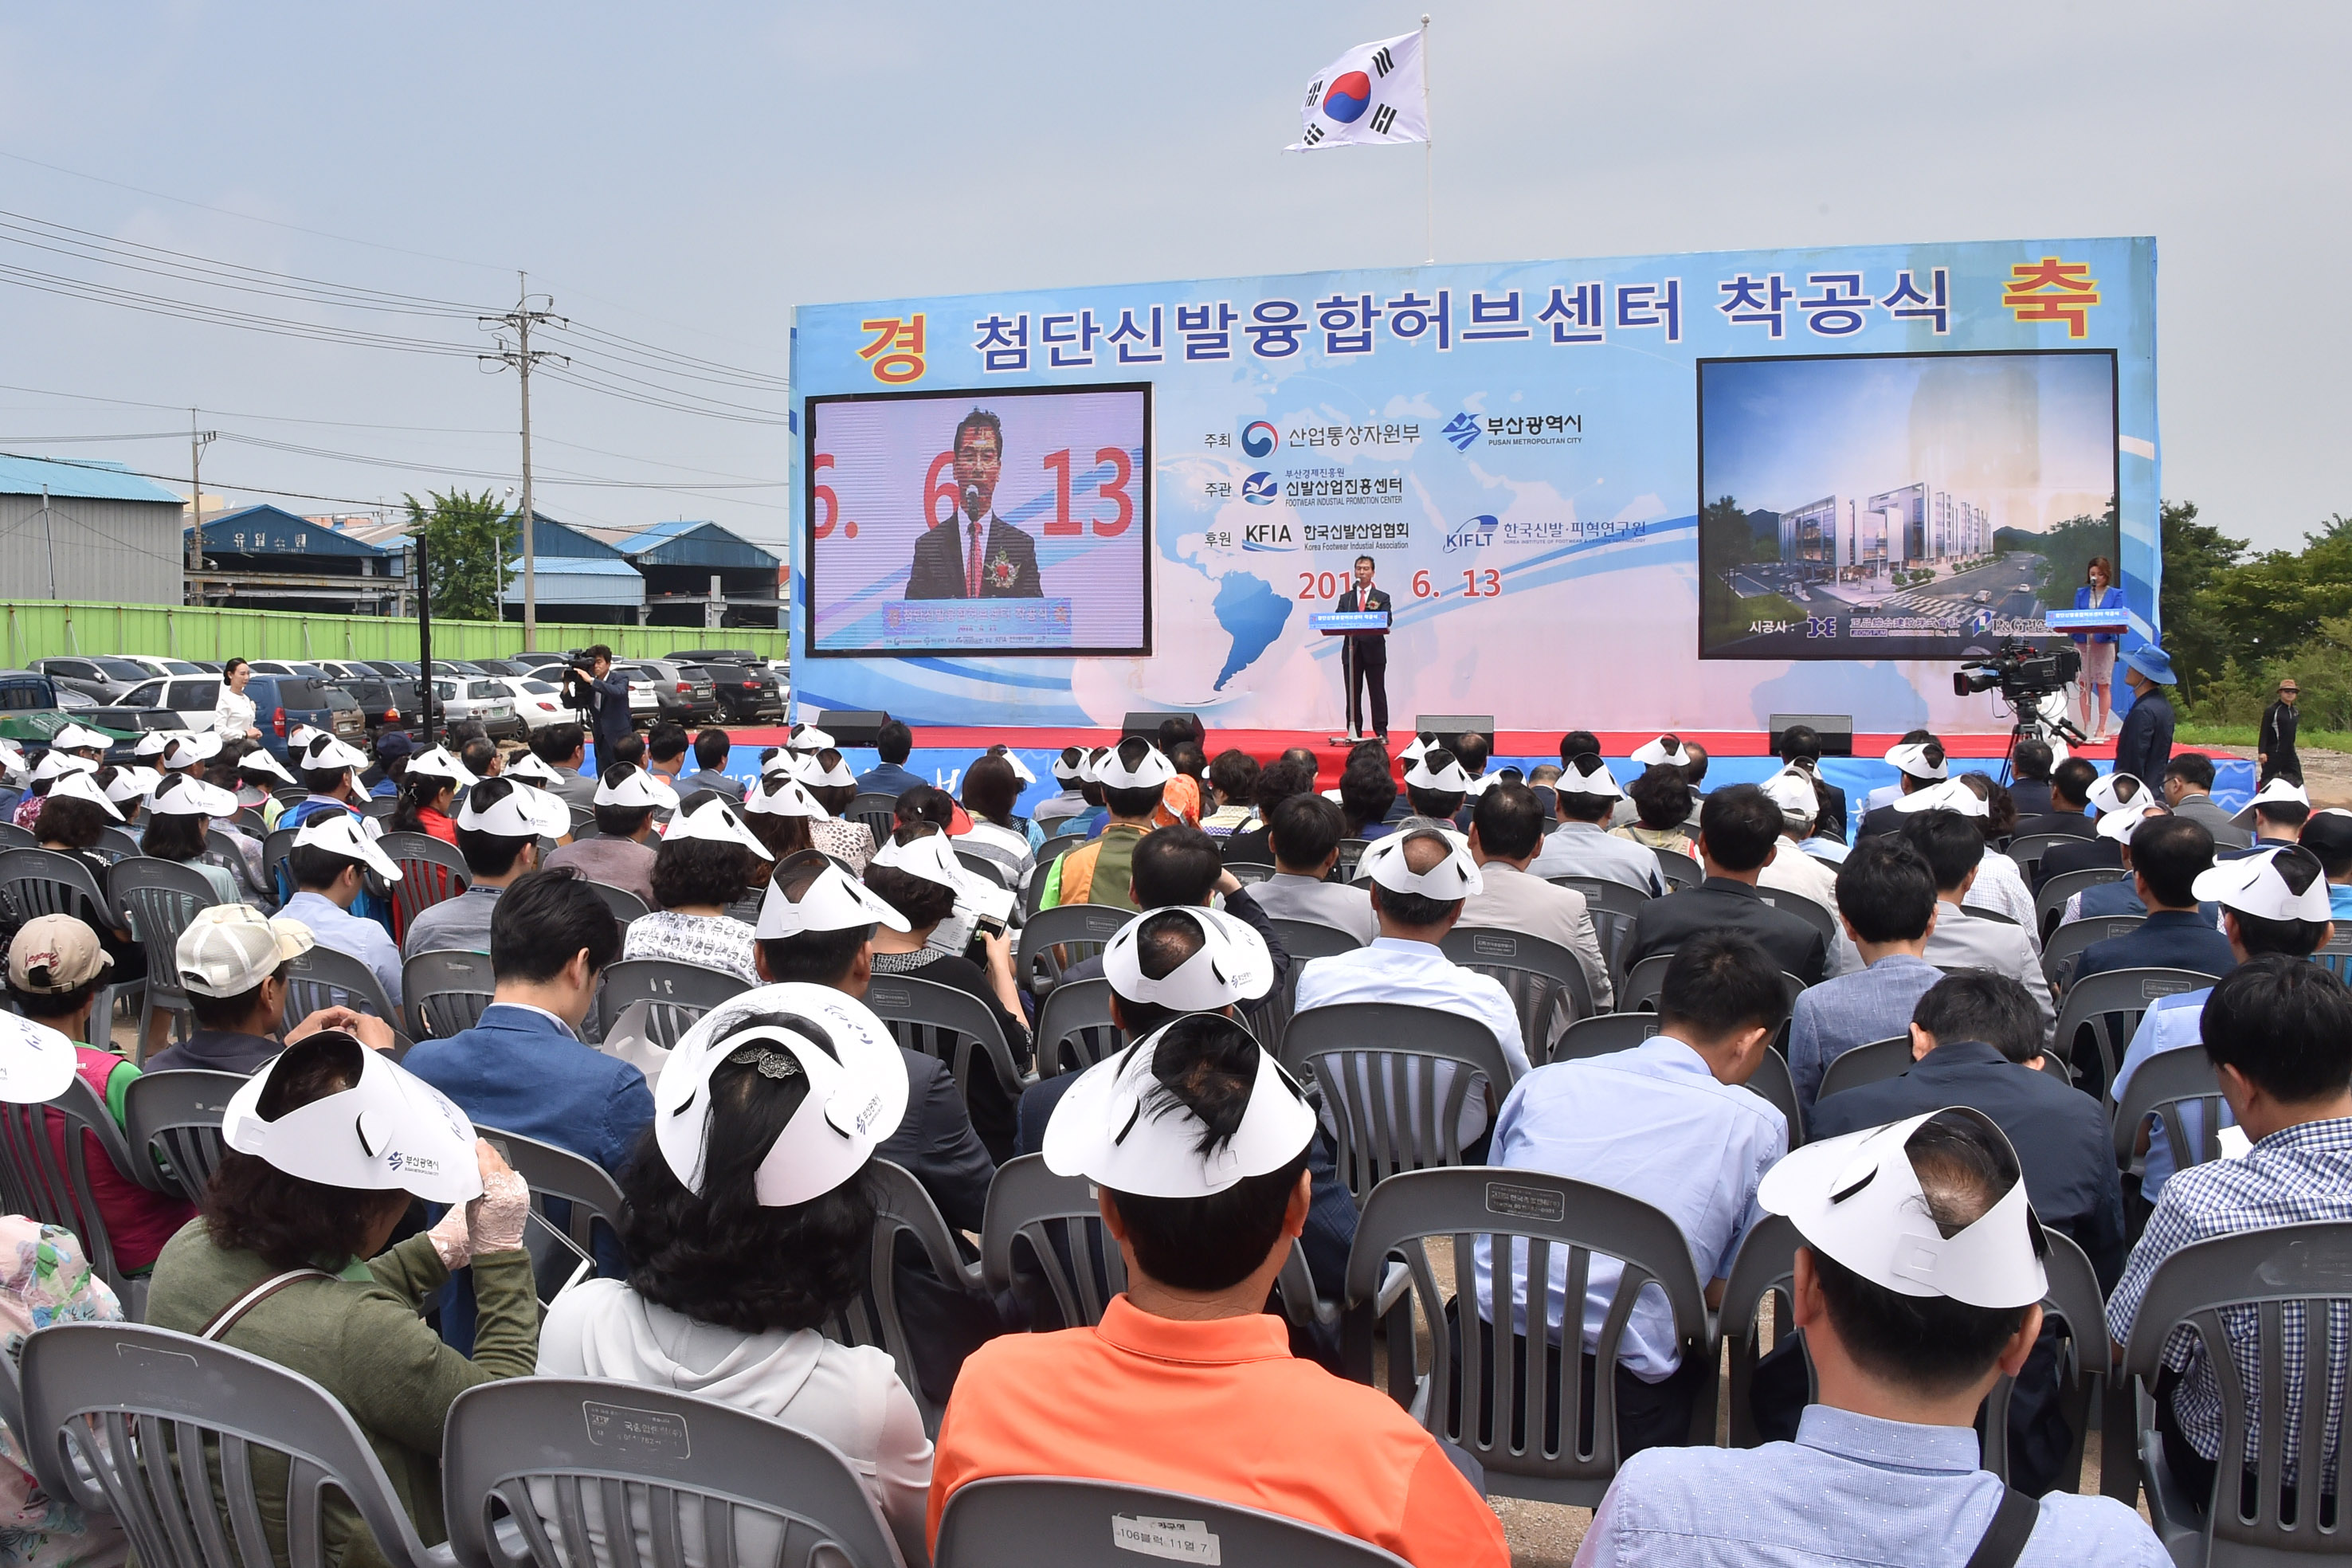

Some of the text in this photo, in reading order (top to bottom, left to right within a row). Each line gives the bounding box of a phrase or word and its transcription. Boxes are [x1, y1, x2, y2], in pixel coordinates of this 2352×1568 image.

[2002, 257, 2100, 338] 축
[973, 268, 1950, 373] 첨단신발융합허브센터 착공식
[858, 315, 926, 382] 경
[1488, 414, 1582, 436] 부산광역시
[1205, 433, 1231, 449] 주최
[1289, 424, 1420, 448] 산업통상자원부
[1285, 468, 1345, 479] 부산경제진흥원
[1044, 447, 1133, 537] 13
[1205, 482, 1232, 497] 주관
[1286, 478, 1402, 496] 신발산업진흥센터
[1285, 498, 1315, 507] FOOTWEAR
[1346, 496, 1379, 505] PROMOTION
[1205, 531, 1231, 547] 후원
[1245, 525, 1292, 543] KFIA
[1304, 523, 1409, 541] 한국신발산업협회
[1446, 534, 1493, 547] KIFLT
[1304, 543, 1321, 551] Korea
[1375, 541, 1409, 550] Association
[1299, 569, 1501, 599] 201 6. 13
[1749, 621, 1786, 633] 시공사
[406, 1155, 439, 1170] 부산광역시
[1120, 1528, 1163, 1546] 106블럭
[1200, 1543, 1208, 1553] 7
